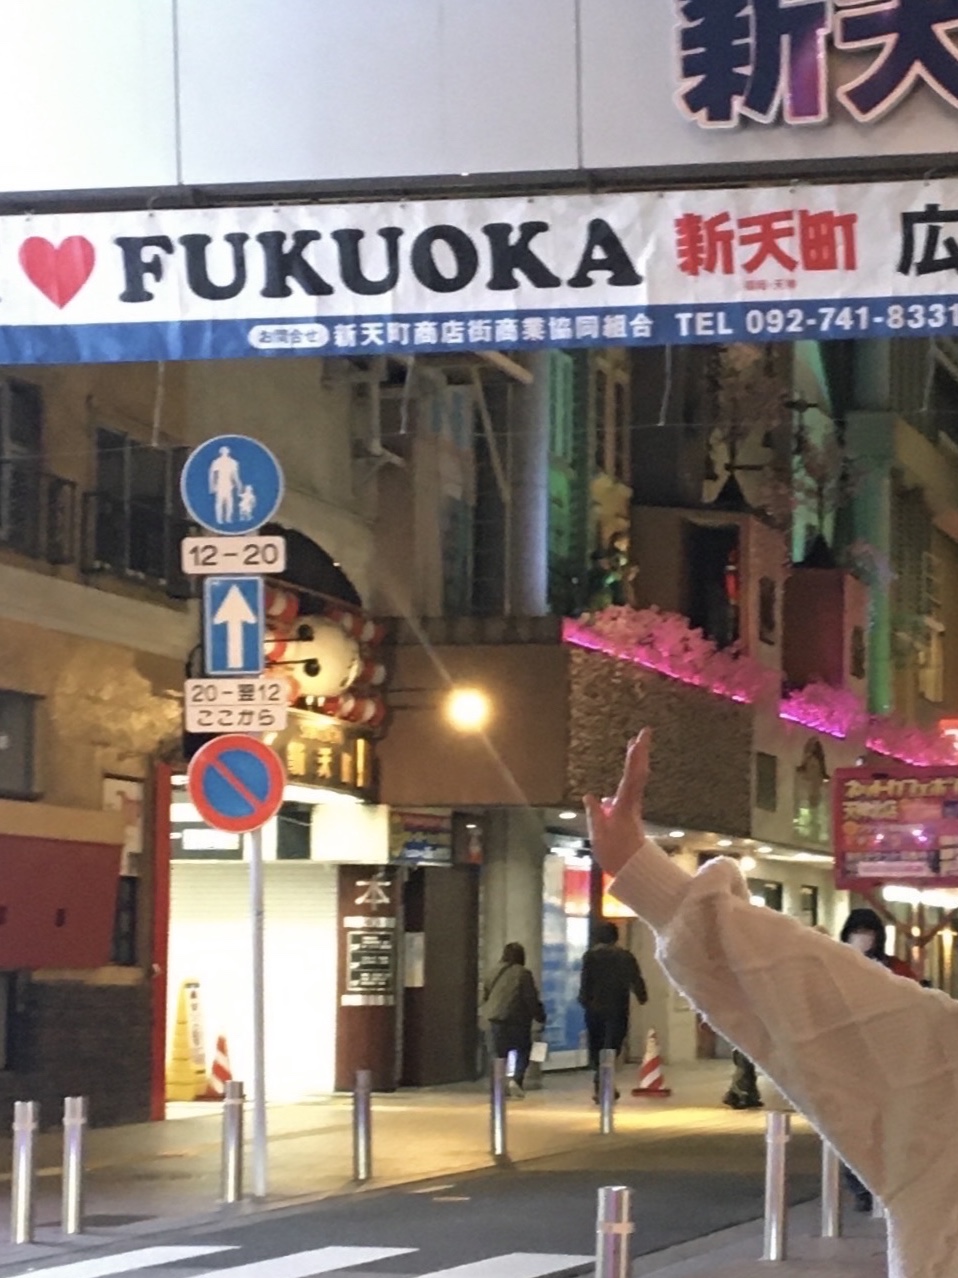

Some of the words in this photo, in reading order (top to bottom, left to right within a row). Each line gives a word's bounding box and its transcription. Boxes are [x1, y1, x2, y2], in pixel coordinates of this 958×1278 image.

[674, 209, 858, 276] 新天町
[114, 218, 643, 303] FUKUOKA
[333, 313, 653, 347] 新天町商店街商業協同組合
[675, 312, 733, 336] TEL
[189, 544, 278, 566] 12-20
[197, 709, 275, 726] ここから
